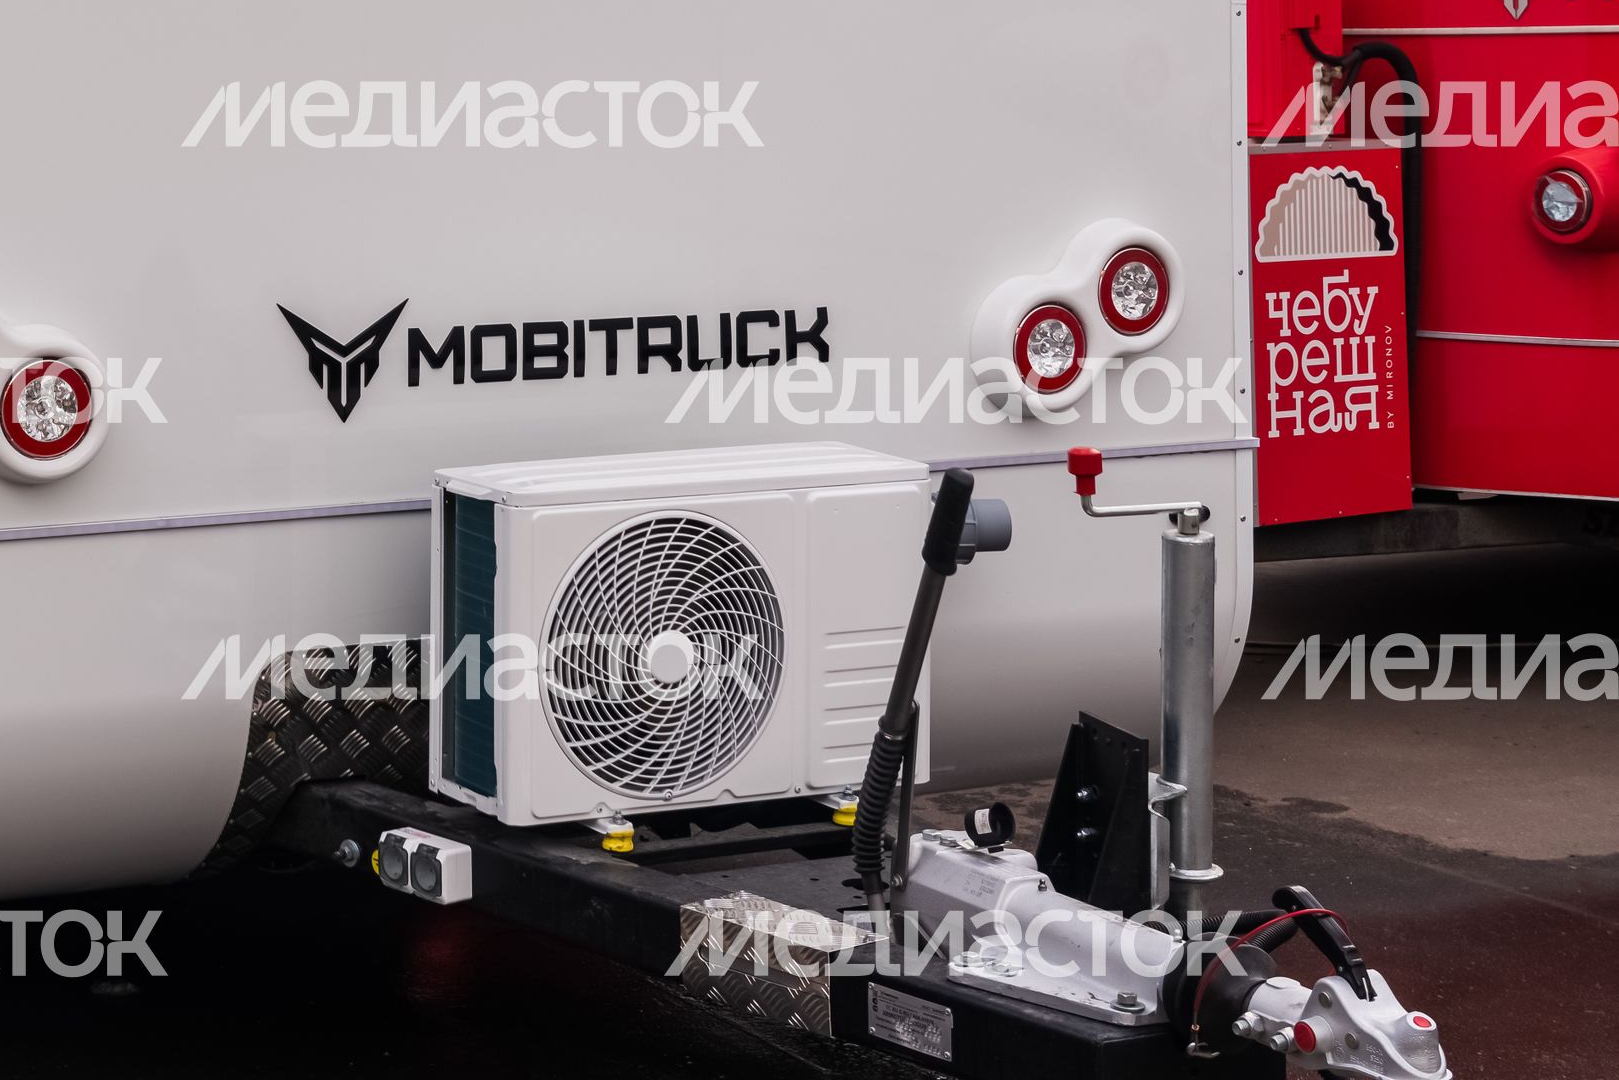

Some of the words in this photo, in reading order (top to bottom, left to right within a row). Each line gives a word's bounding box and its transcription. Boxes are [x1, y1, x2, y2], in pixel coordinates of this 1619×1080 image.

[1265, 269, 1379, 337] чебу
[407, 306, 831, 388] MOBITRUCK
[1266, 335, 1377, 395] реш
[1384, 325, 1394, 400] MIRONOV
[1386, 411, 1395, 429] BY
